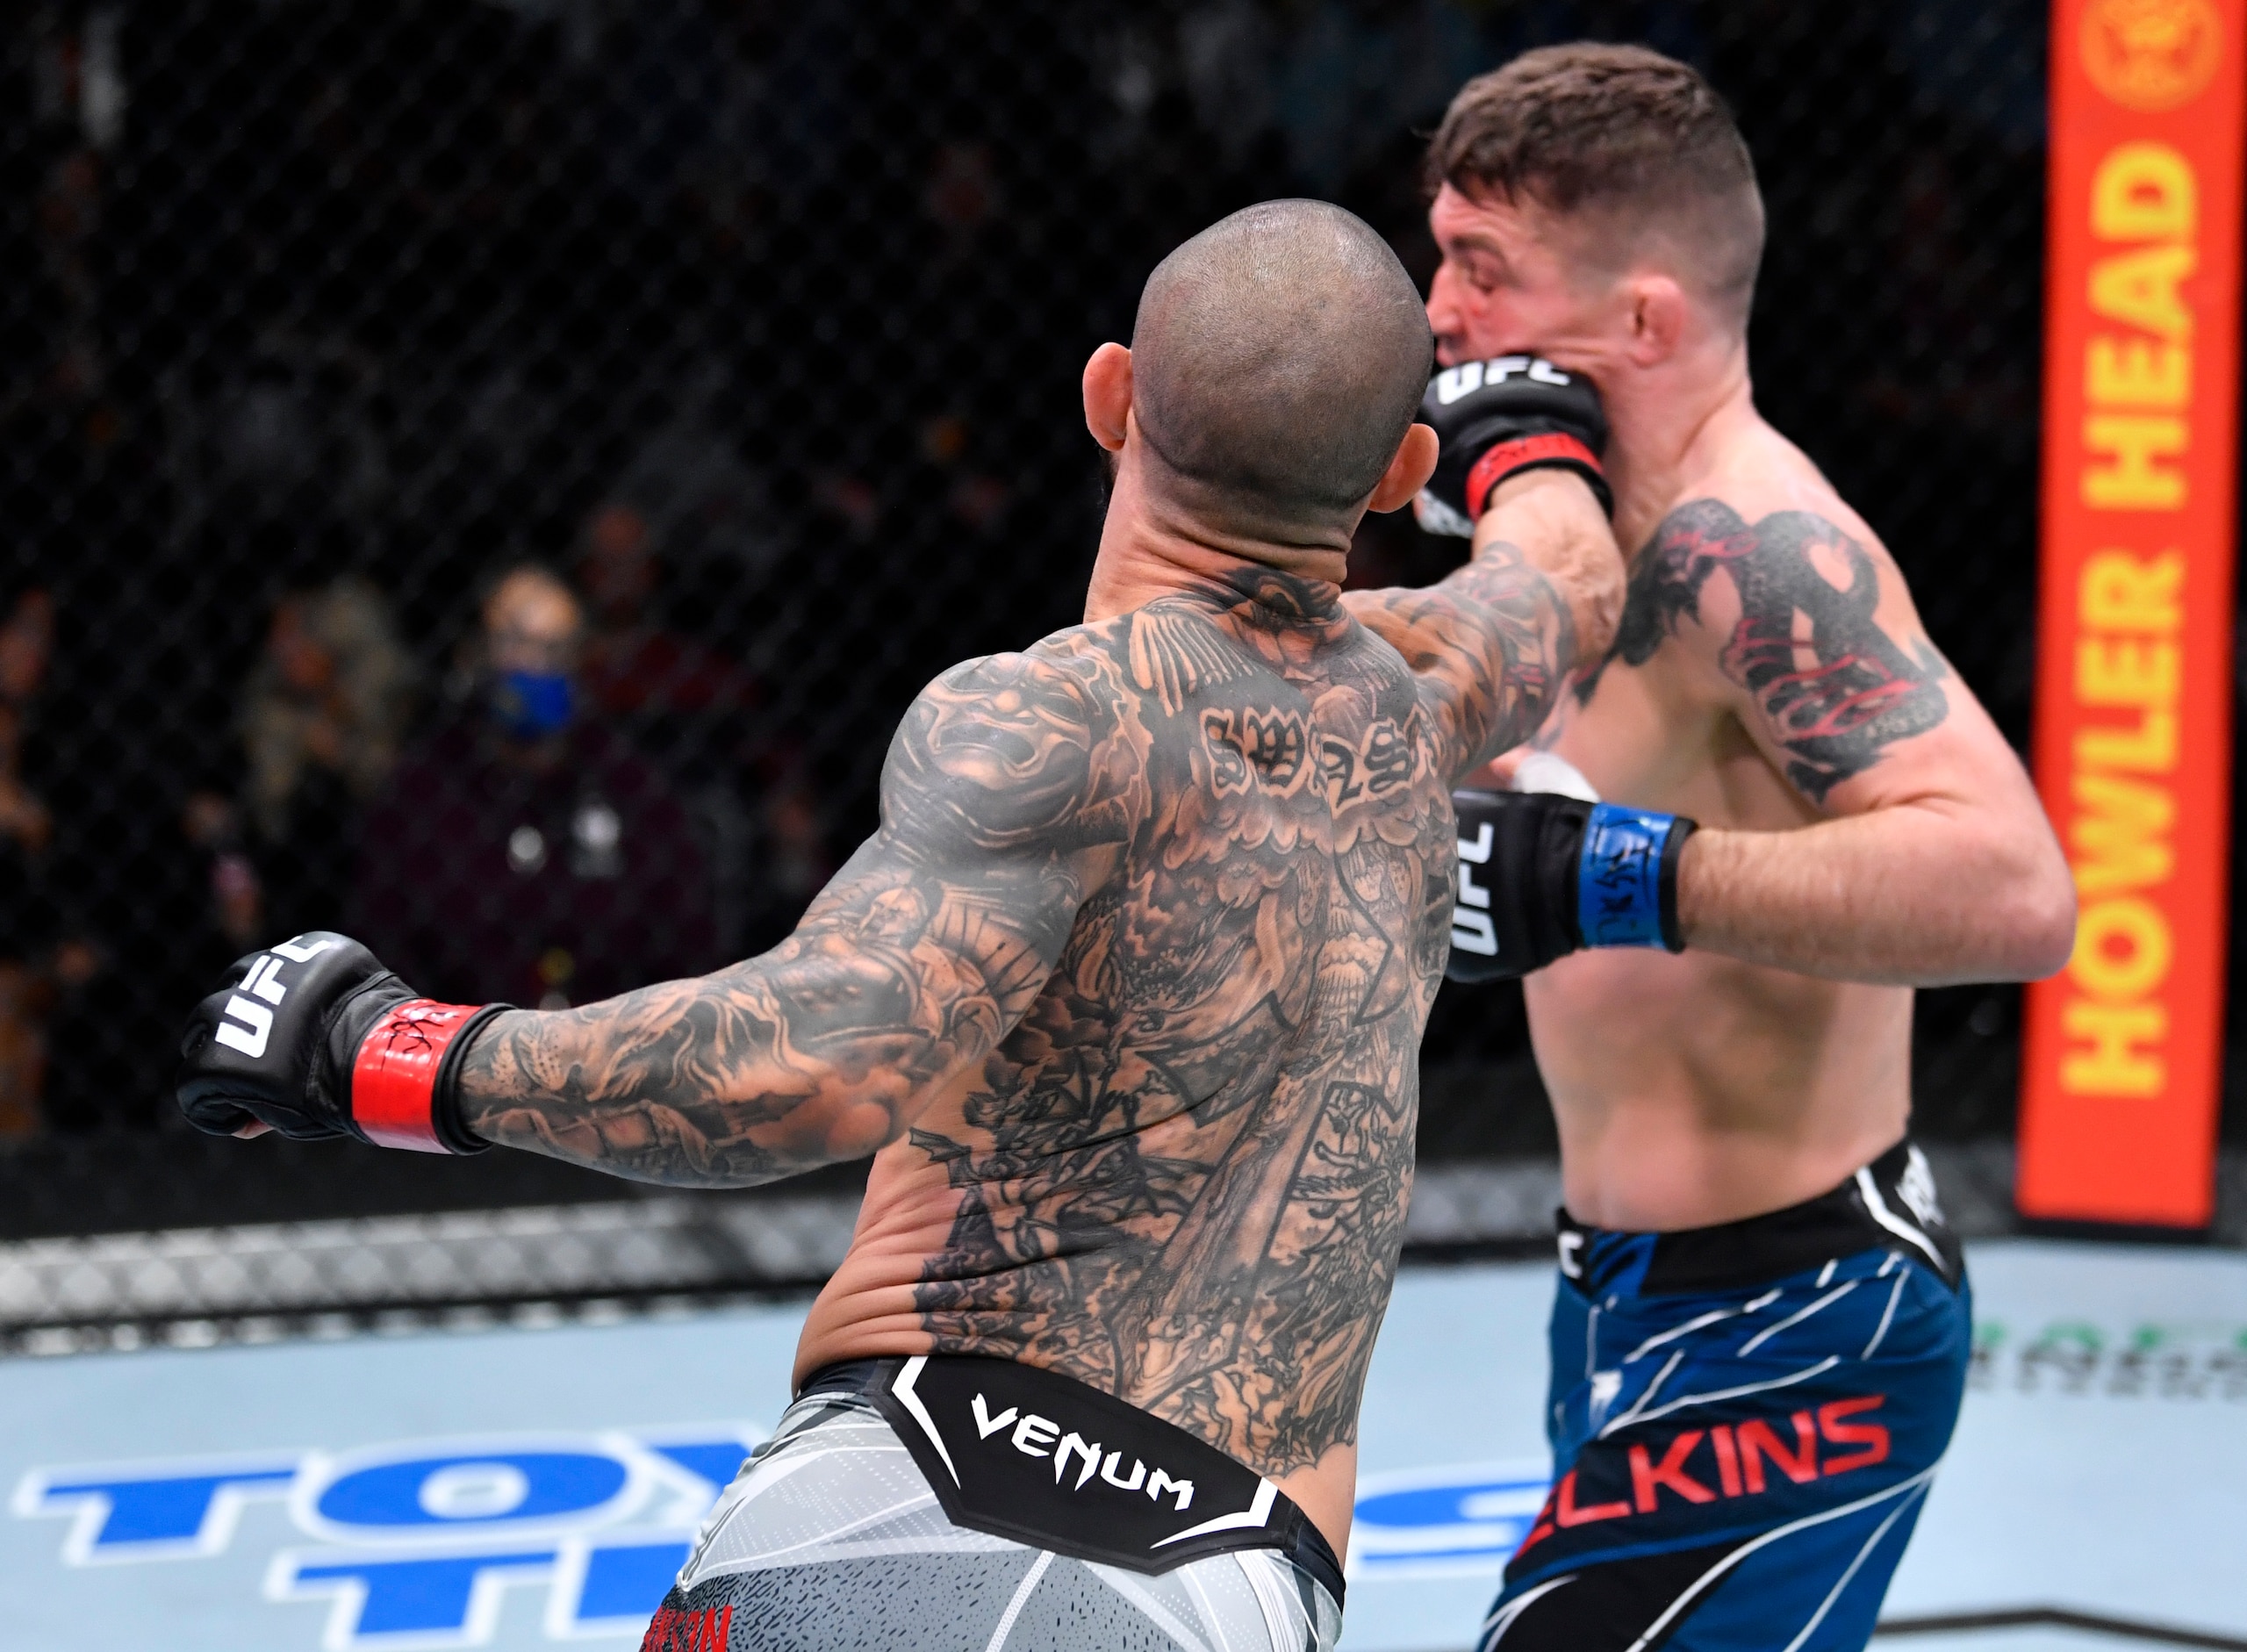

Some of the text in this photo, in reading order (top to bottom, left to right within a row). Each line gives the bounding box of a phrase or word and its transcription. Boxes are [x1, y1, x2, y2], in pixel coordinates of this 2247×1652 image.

[1437, 356, 1570, 406] UFC
[2059, 140, 2199, 1097] HOWLER HEAD
[214, 935, 332, 1059] UFC
[971, 1392, 1195, 1511] VENUM
